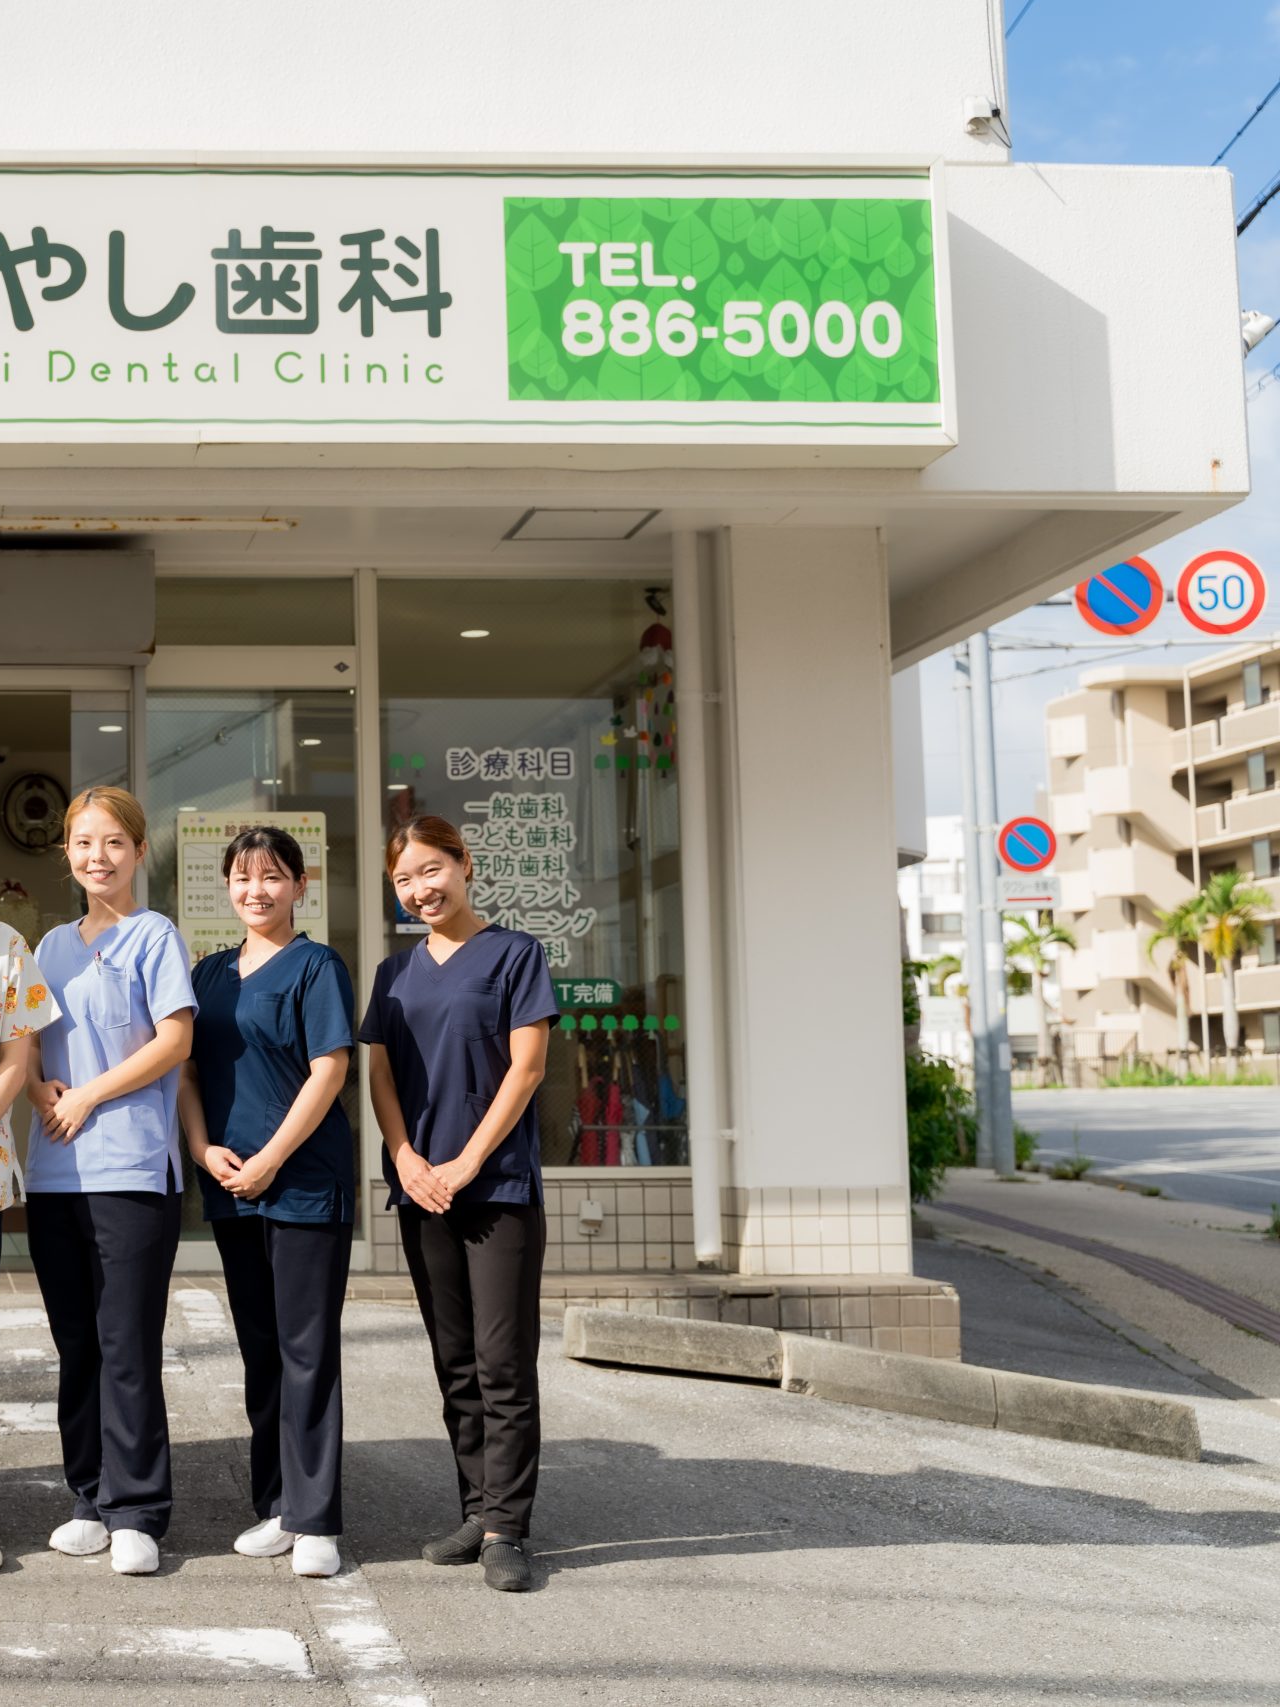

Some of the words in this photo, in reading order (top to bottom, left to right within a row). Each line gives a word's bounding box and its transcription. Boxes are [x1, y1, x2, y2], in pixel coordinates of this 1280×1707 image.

[558, 241, 697, 291] TEL.
[561, 299, 903, 359] 886-5000
[48, 350, 240, 384] Dental
[273, 351, 446, 385] Clinic
[1196, 574, 1246, 612] 50
[449, 750, 572, 778] 診療科目
[466, 796, 564, 819] 一般歯科
[463, 825, 573, 848] こども歯科
[471, 854, 565, 877] 予防歯科
[469, 881, 577, 905] ンプラント
[554, 983, 614, 1004] T完備
